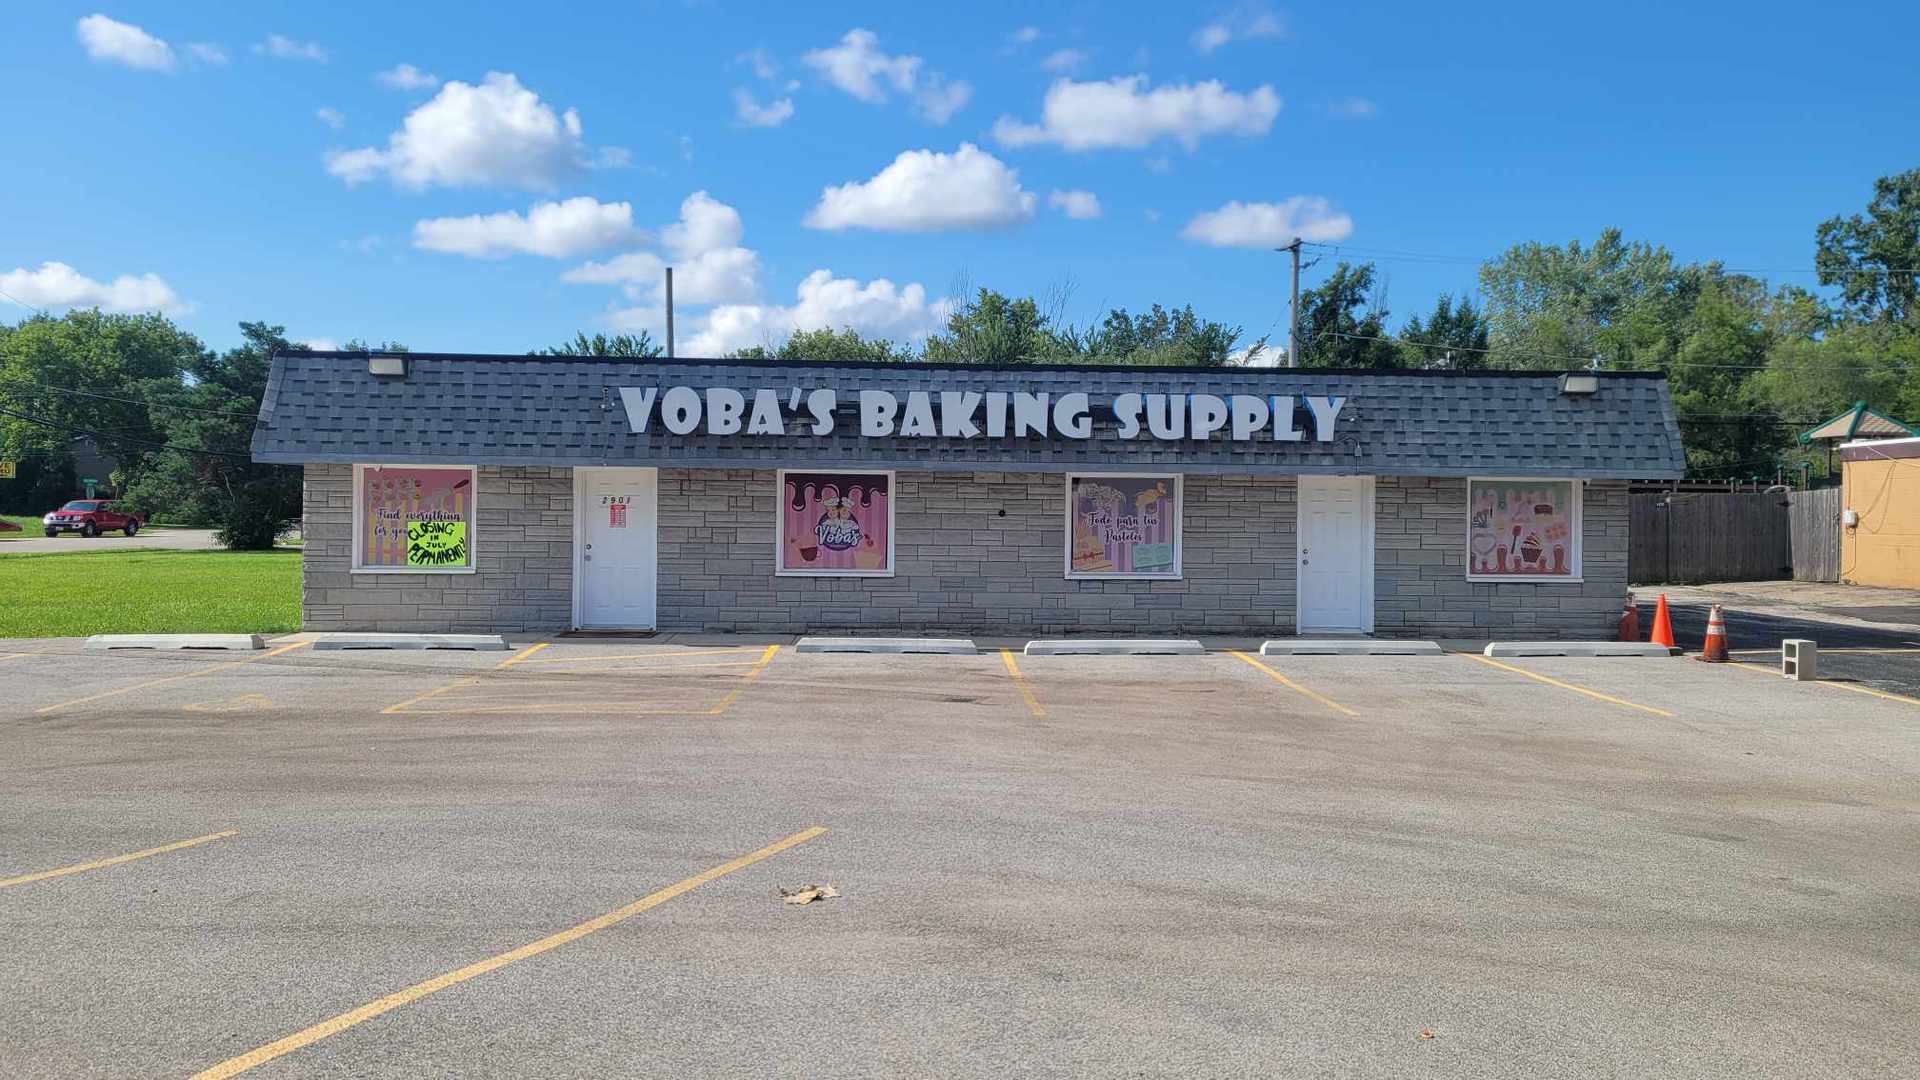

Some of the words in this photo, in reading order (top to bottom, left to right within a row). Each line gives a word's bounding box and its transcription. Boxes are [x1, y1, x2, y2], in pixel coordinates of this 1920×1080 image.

[618, 386, 837, 437] VOBA'S
[859, 390, 1093, 439] BAKING
[1112, 392, 1347, 442] SUPPLY
[602, 496, 630, 505] 2901
[376, 508, 400, 521] Find
[1088, 511, 1111, 525] Todo
[1117, 516, 1139, 529] para
[1144, 515, 1158, 525] tus
[408, 522, 455, 542] CLOSING
